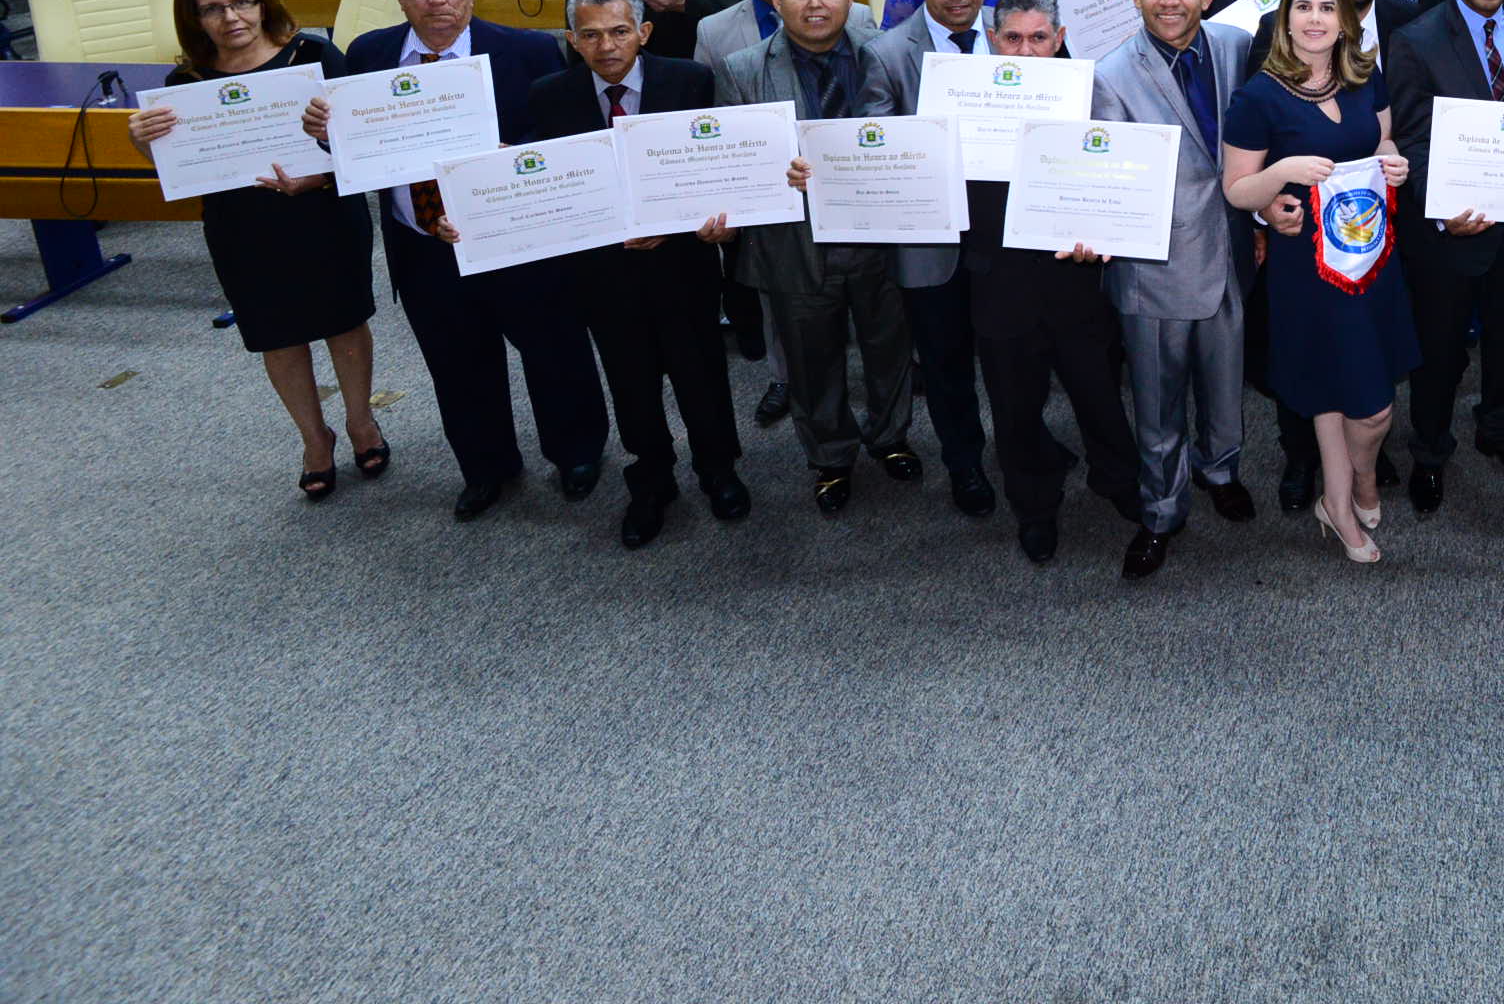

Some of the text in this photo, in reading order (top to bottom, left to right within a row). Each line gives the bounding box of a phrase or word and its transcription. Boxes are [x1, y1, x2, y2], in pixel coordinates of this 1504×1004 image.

[647, 148, 682, 157] Diploma
[696, 144, 723, 153] Honra
[739, 139, 767, 149] Mérito
[1458, 134, 1490, 144] Diploma
[471, 185, 508, 197] Diploma
[524, 177, 550, 188] Honra
[566, 168, 595, 180] Mérito
